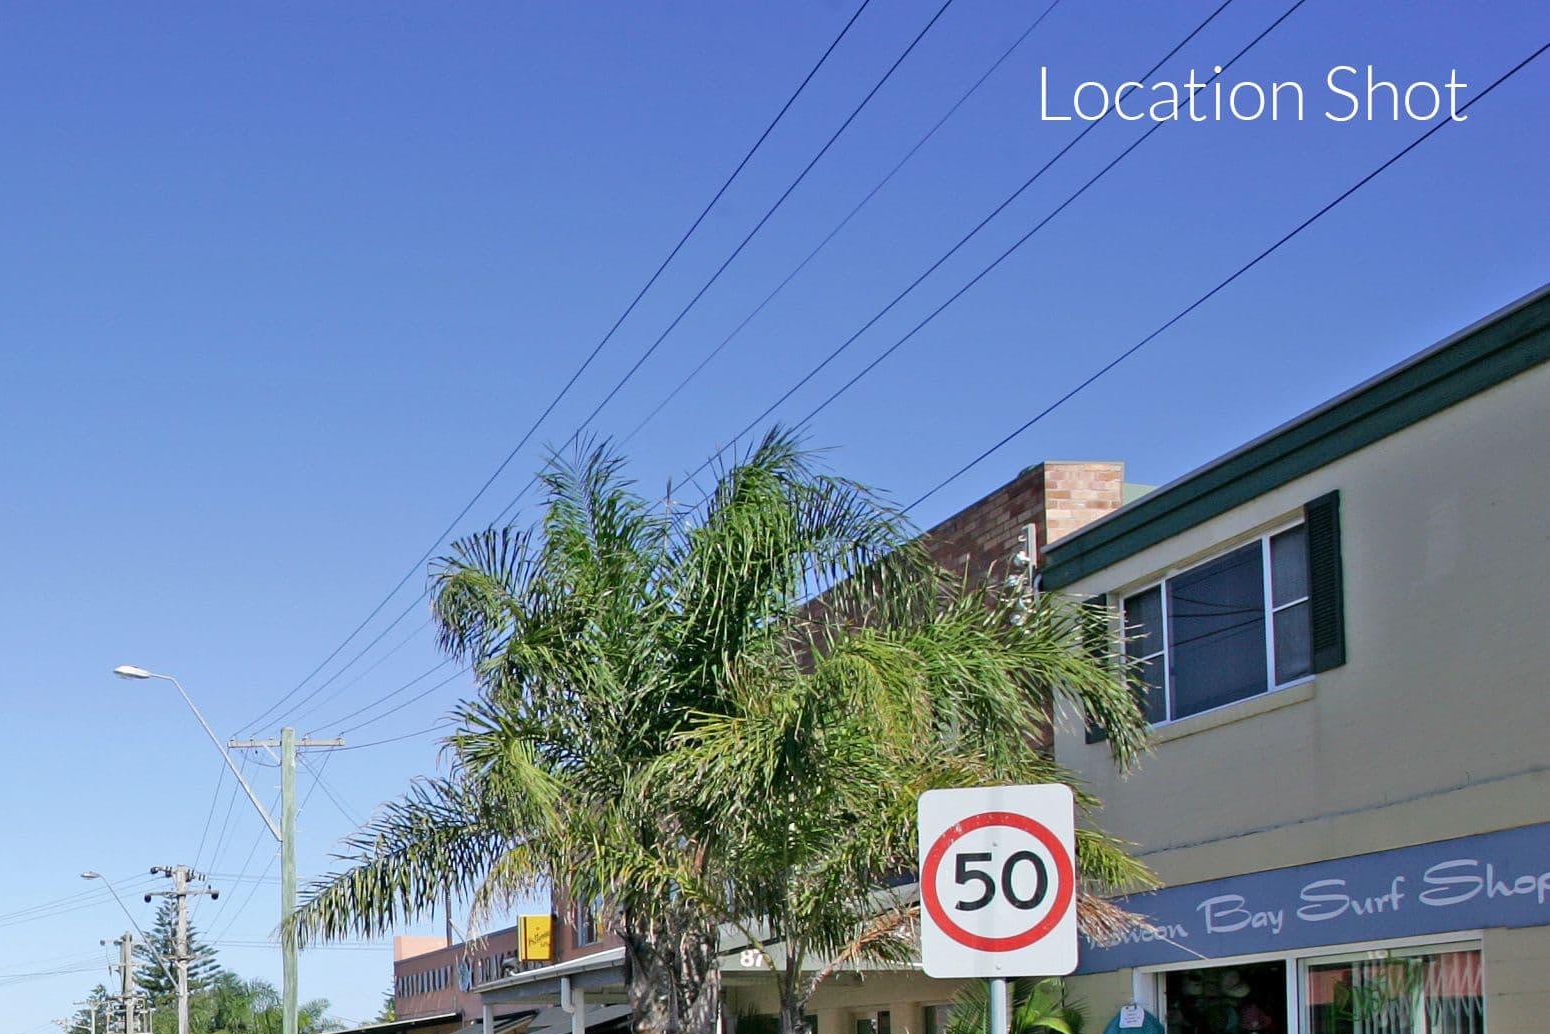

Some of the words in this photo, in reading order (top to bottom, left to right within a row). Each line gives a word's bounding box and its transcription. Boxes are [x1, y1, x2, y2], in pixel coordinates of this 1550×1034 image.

[954, 850, 1049, 912] 50
[1196, 894, 1283, 934] Bay
[1296, 875, 1405, 922] Surf
